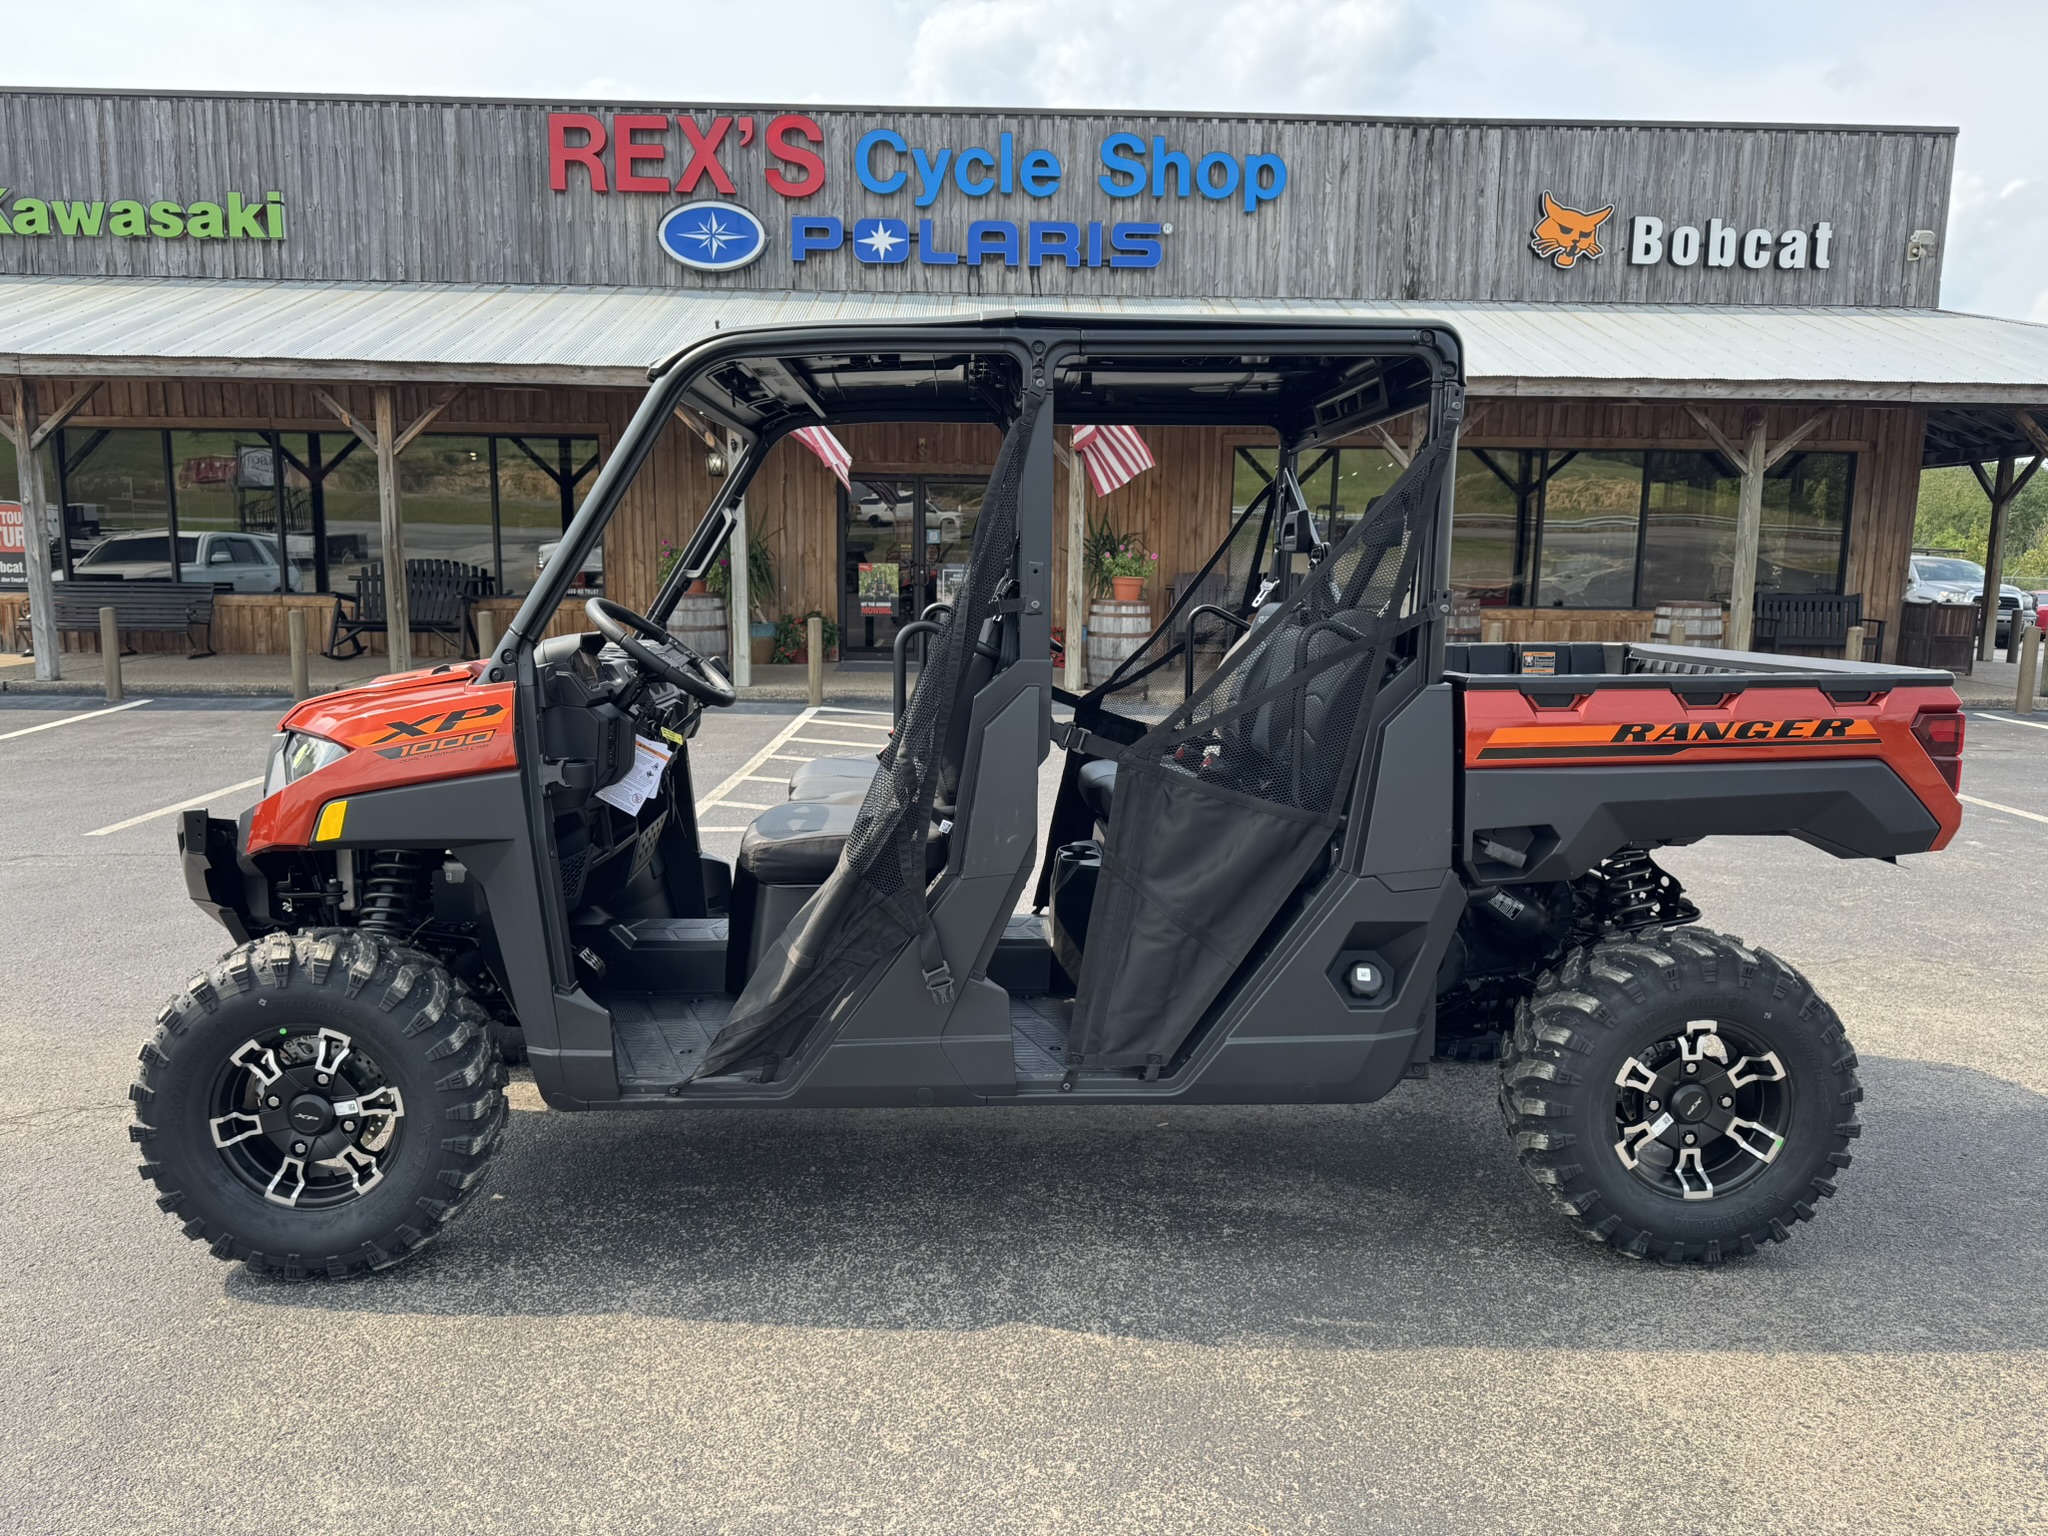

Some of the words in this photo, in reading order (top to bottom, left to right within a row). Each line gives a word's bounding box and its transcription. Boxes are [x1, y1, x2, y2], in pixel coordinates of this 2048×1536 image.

[548, 113, 826, 198] REX'S
[854, 129, 1062, 208] Cycle
[1098, 132, 1288, 214] Shop
[1632, 215, 1833, 270] Bobcat
[1, 511, 23, 525] TOU
[861, 607, 893, 615] MOWING.
[367, 704, 504, 745] XP
[1609, 718, 1855, 743] RANGER
[399, 756, 420, 764] DUAL
[423, 747, 470, 759] OVERHEAD
[470, 743, 490, 751] CAM
[400, 730, 495, 757] 1000
[294, 1112, 320, 1121] XP
[1674, 1190, 1785, 1236] X-TERRAIN
